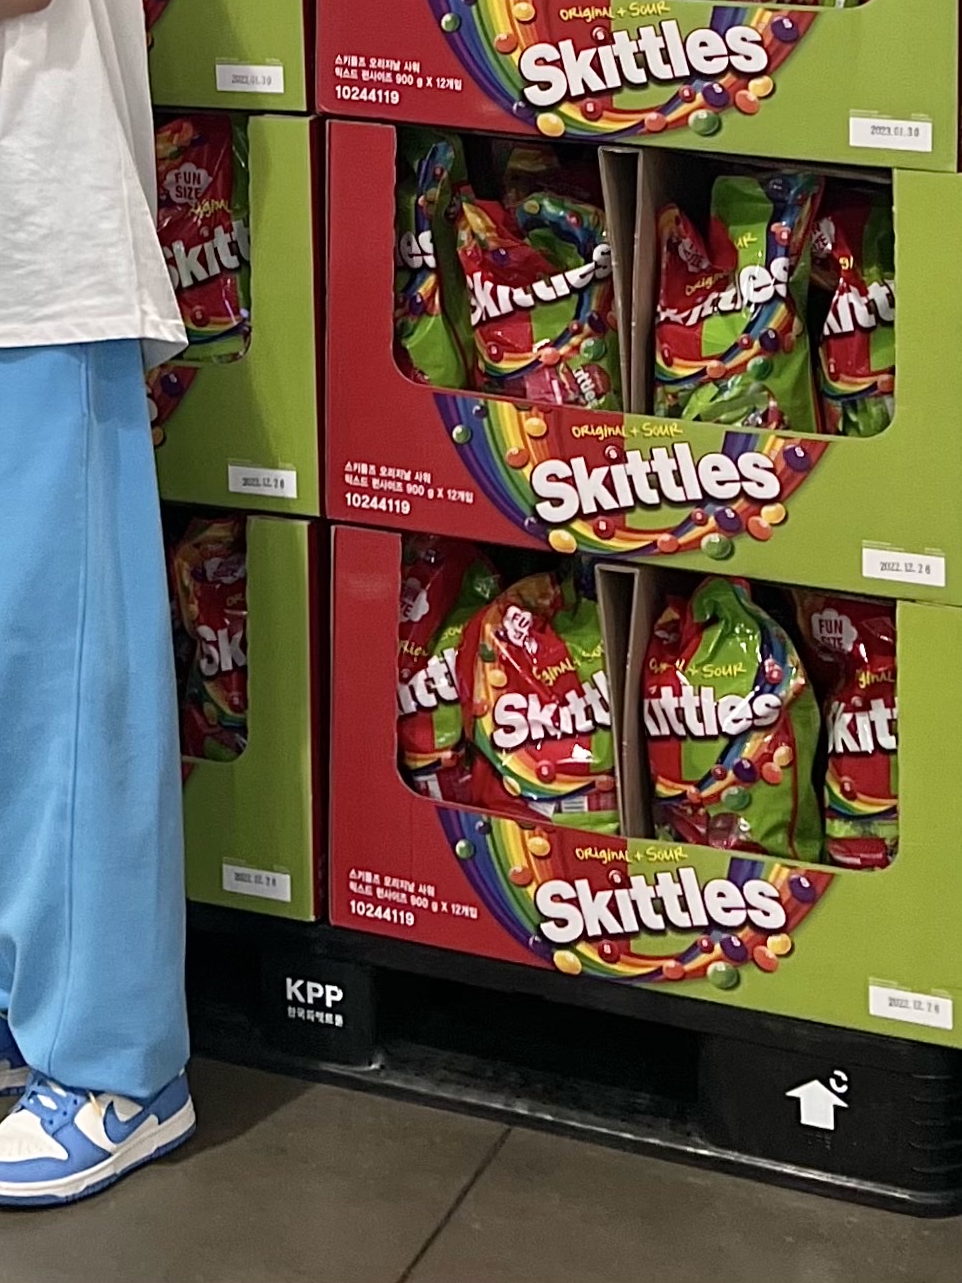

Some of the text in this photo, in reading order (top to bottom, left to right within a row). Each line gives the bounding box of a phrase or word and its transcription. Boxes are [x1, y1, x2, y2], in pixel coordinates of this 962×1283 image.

[335, 55, 366, 66] 스키틀즈
[518, 20, 768, 108] Skittles
[396, 74, 413, 85] 900
[336, 85, 399, 104] 10244119
[174, 172, 201, 186] FUN
[175, 185, 202, 199] SIZE
[345, 462, 376, 475] 스키틀즈
[406, 485, 424, 496] 900
[530, 442, 782, 524] Skittles
[345, 493, 410, 514] 10244119
[818, 617, 843, 635] FUN
[350, 900, 414, 926] 10244119
[536, 866, 787, 945] Skittles
[286, 977, 343, 1008] KPP
